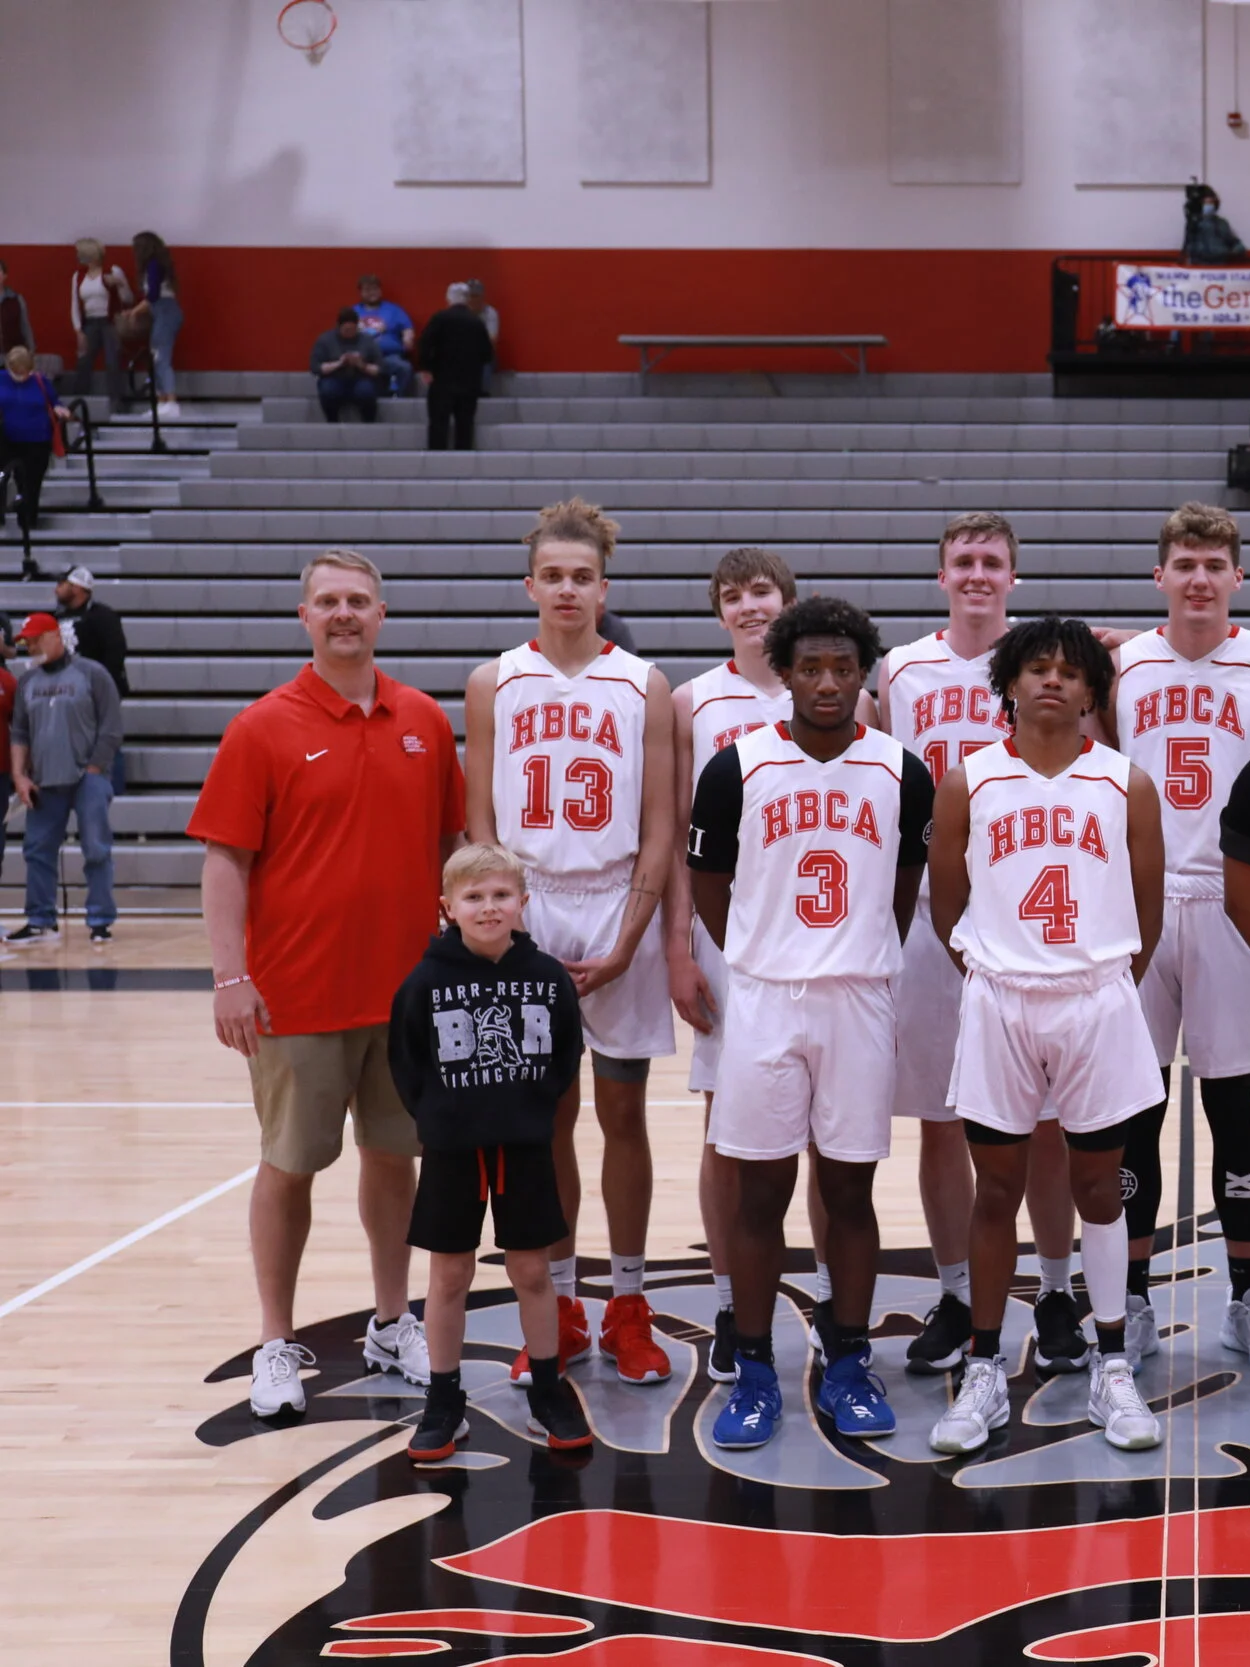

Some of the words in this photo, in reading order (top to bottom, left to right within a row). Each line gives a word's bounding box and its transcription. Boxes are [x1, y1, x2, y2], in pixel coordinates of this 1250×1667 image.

[509, 702, 623, 758] HBCA
[1133, 685, 1245, 740] HBCA
[521, 755, 613, 831] 13
[923, 740, 997, 791] 1
[1165, 737, 1212, 810] 5
[762, 789, 882, 849] HBCA
[988, 805, 1108, 867] HBCA
[796, 850, 848, 928] 3
[1019, 865, 1078, 944] 4
[432, 982, 557, 1003] BARR-REEVE
[432, 1008, 476, 1063] B
